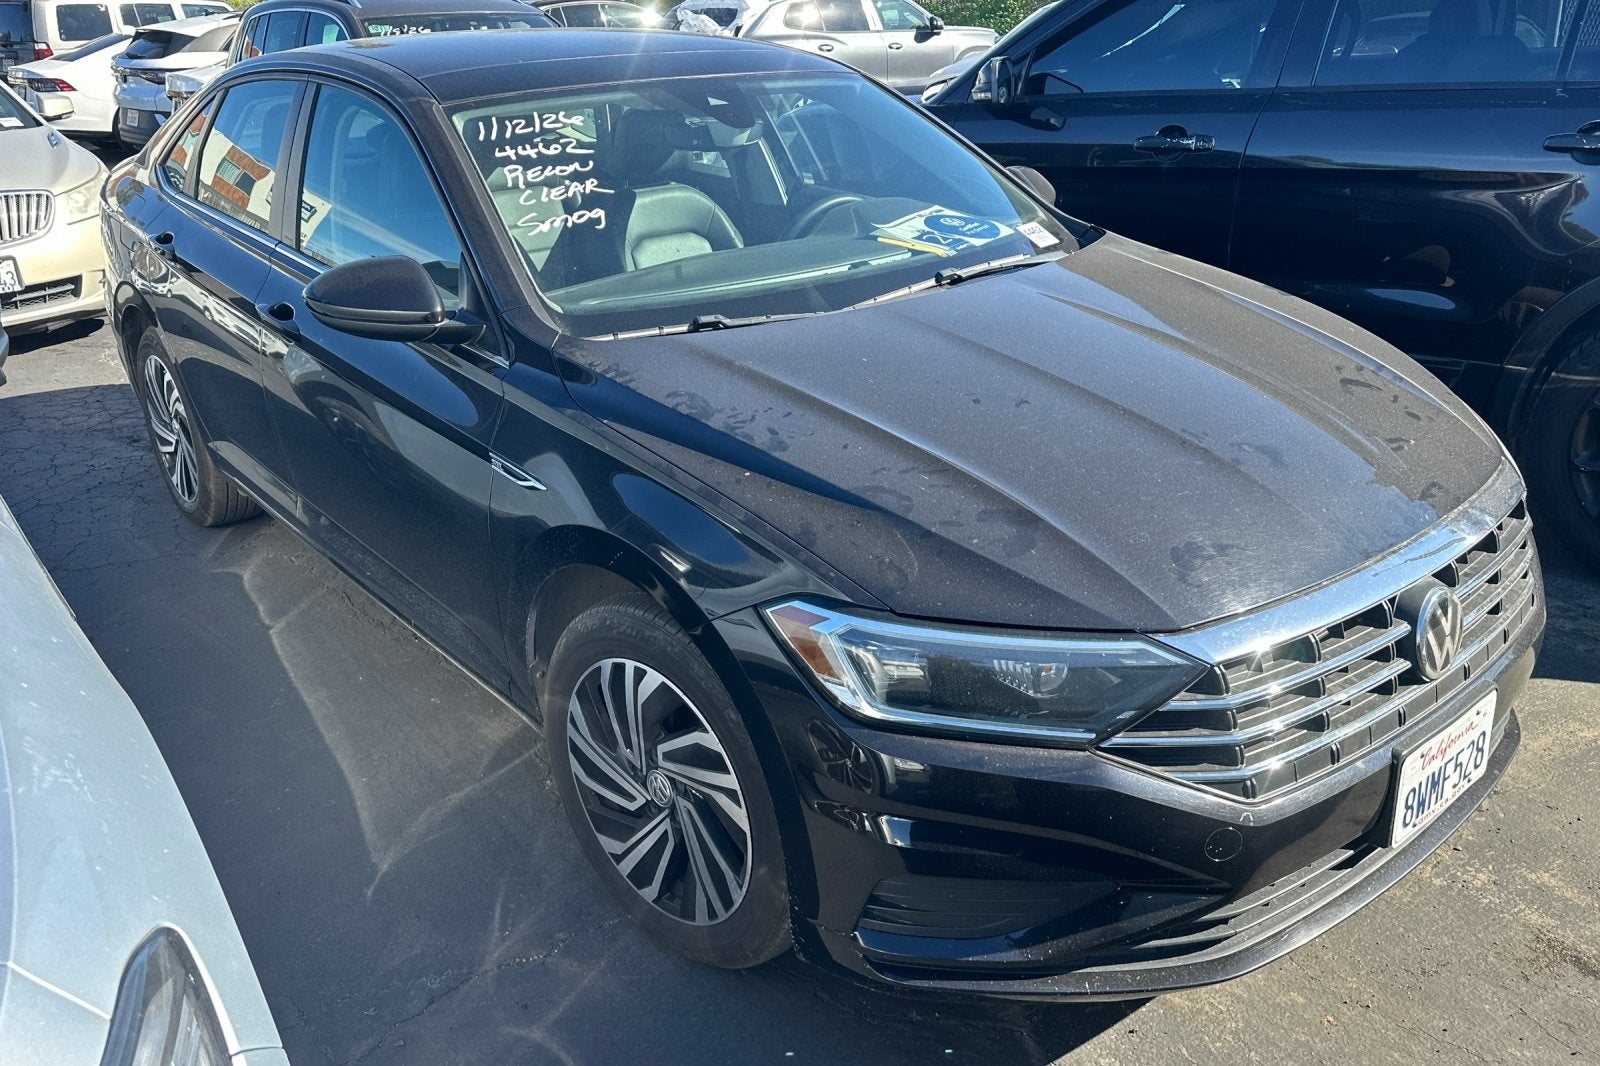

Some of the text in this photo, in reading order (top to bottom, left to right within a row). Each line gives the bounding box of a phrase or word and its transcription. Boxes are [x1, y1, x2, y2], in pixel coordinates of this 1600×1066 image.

[495, 138, 595, 160] 4462
[1421, 721, 1478, 771] California
[1402, 730, 1487, 829] 8WMF528
